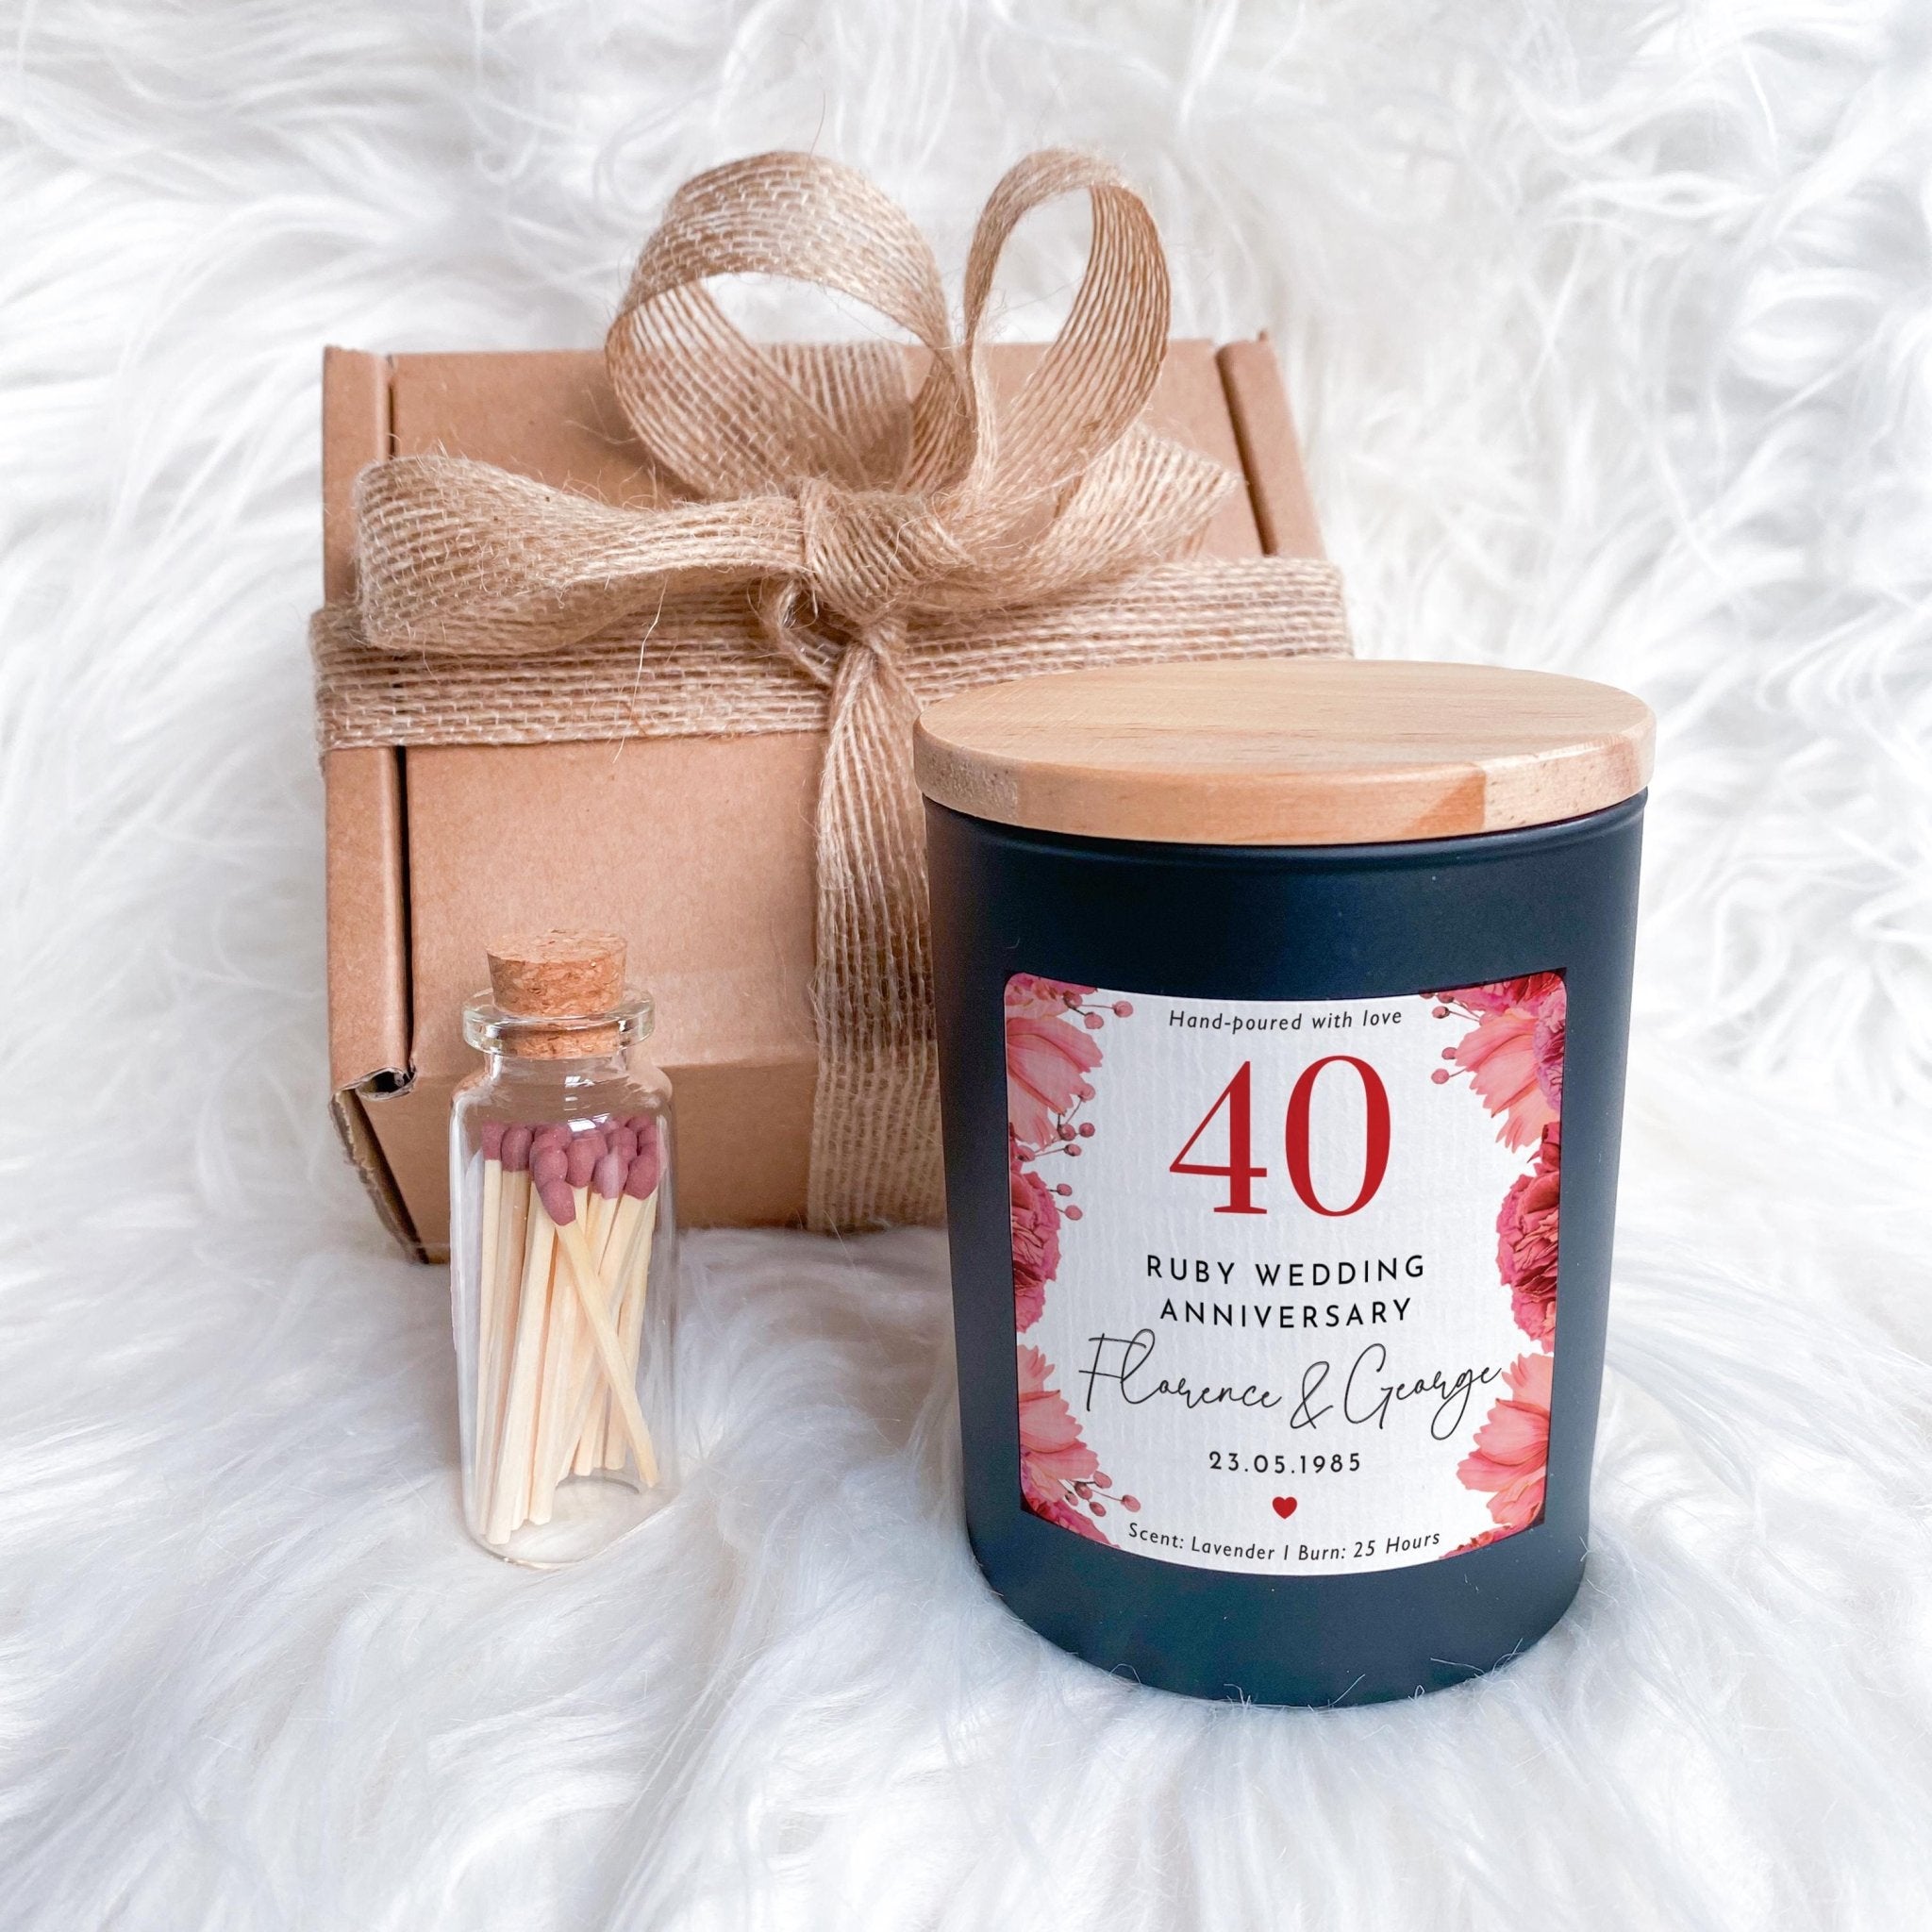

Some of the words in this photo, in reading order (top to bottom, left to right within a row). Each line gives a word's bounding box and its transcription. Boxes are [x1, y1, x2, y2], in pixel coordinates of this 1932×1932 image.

[1169, 1009, 1303, 1035] Hand-poured
[1312, 1010, 1353, 1029] with
[1362, 1009, 1402, 1026] love
[1169, 1055, 1391, 1217] 40
[1147, 1254, 1235, 1285] RUBY
[1255, 1254, 1424, 1287] WEDDING
[1159, 1297, 1411, 1329] ANNIVERSARY
[1078, 1327, 1283, 1412] Florence
[1290, 1360, 1334, 1429] &
[1343, 1342, 1502, 1441] George
[1208, 1450, 1360, 1474] 23.05.1985
[1128, 1522, 1185, 1548] Scent:
[1191, 1536, 1275, 1560] Lavender
[1298, 1544, 1346, 1560] Burn:
[1353, 1540, 1375, 1558] 25
[1386, 1533, 1440, 1554] Hours
